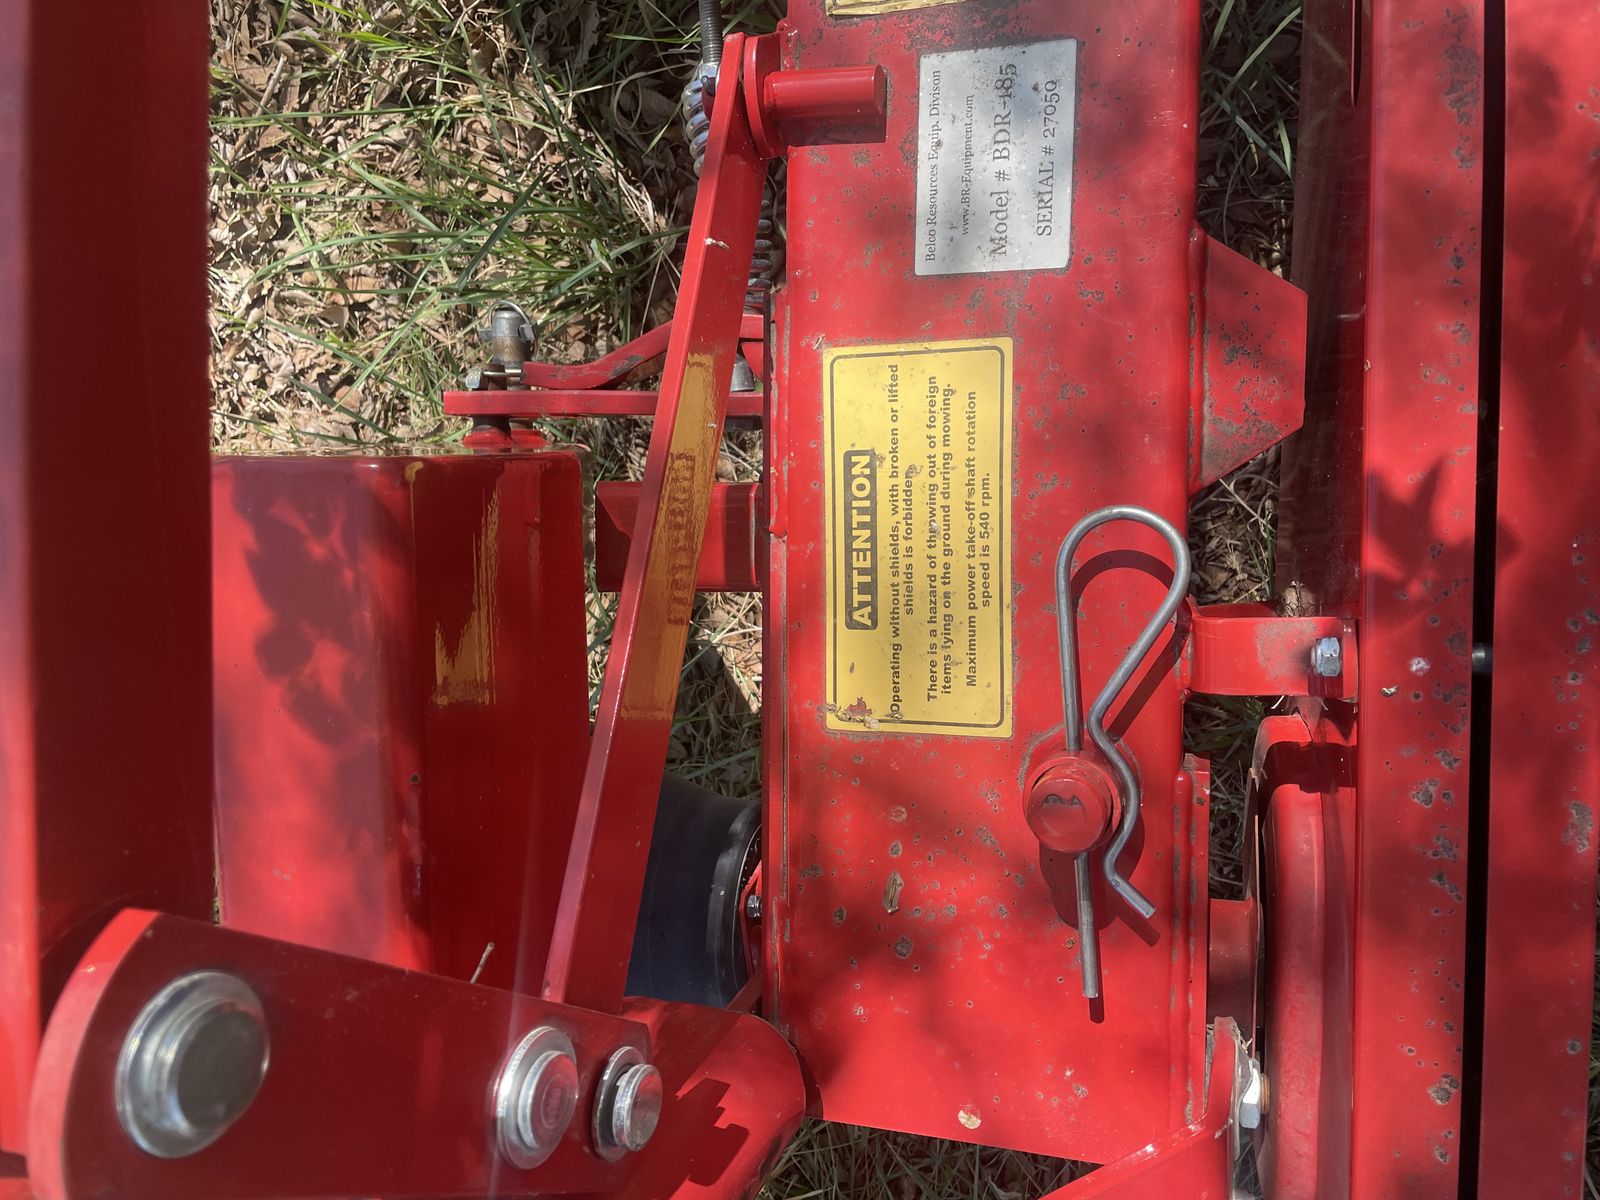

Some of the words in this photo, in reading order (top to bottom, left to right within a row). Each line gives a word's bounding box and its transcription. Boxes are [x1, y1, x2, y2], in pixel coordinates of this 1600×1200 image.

[929, 70, 941, 116] Divison
[993, 63, 1016, 160] BDR-185
[1042, 80, 1059, 138] 27050
[928, 121, 941, 160] Equip.
[1042, 145, 1054, 155] #
[961, 95, 974, 235] www.BR-Equipment.com
[995, 169, 1010, 181] #
[928, 164, 938, 226] Resources
[1037, 162, 1054, 236] SERIAL
[925, 229, 936, 261] Belco
[990, 191, 1009, 256] Model
[888, 364, 898, 402] lifted
[927, 376, 938, 429] foreign
[890, 408, 898, 422] or
[941, 384, 953, 447] mowing.
[966, 391, 976, 451] rotation
[889, 428, 898, 478] broken
[927, 434, 936, 449] of
[928, 454, 936, 478] out
[941, 452, 953, 500] during
[966, 457, 976, 494] shaft
[889, 484, 899, 516] with
[982, 473, 992, 507] rpm.
[926, 484, 939, 549] throwing
[941, 505, 952, 557] ground
[965, 500, 977, 559] take-off
[979, 512, 990, 539] 540
[851, 455, 872, 626] ATTENTION
[888, 521, 901, 577] shields,
[903, 546, 913, 558] is
[927, 555, 936, 569] of
[980, 545, 990, 557] is
[904, 563, 913, 615] shields
[941, 562, 950, 585] the
[968, 564, 978, 610] power
[980, 563, 992, 607] speed
[890, 582, 900, 638] without
[927, 574, 937, 624] hazard
[943, 591, 951, 608] on
[927, 643, 937, 654] is
[930, 629, 937, 637] a
[941, 614, 953, 649] lying
[966, 615, 976, 686] Maximum
[890, 643, 902, 712] Operating
[927, 660, 937, 701] There
[941, 655, 951, 694] items
